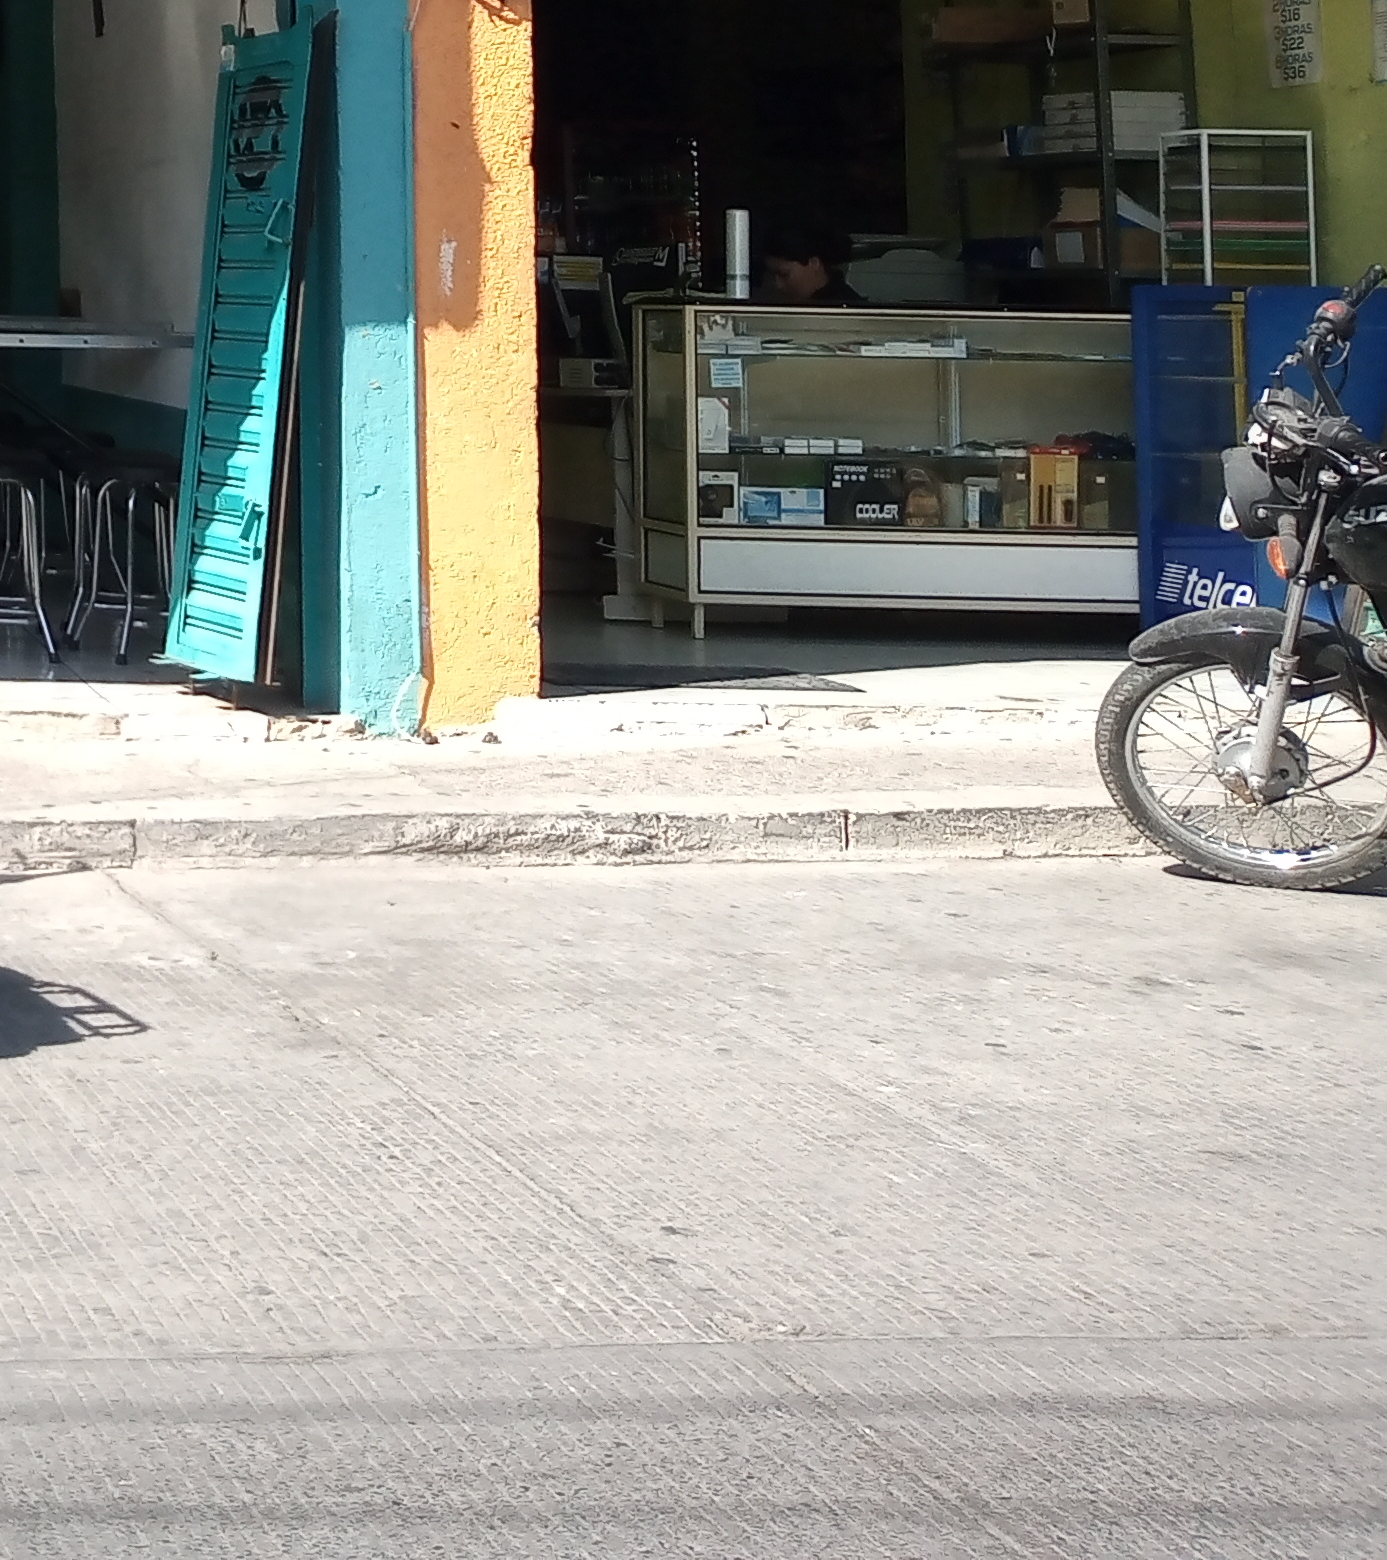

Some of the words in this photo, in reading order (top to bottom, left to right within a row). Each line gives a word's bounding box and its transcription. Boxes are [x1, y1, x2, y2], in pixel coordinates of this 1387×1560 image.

[1281, 8, 1301, 24] $16
[1282, 36, 1304, 53] $22
[1284, 65, 1306, 81] $36
[855, 503, 900, 521] COOLER
